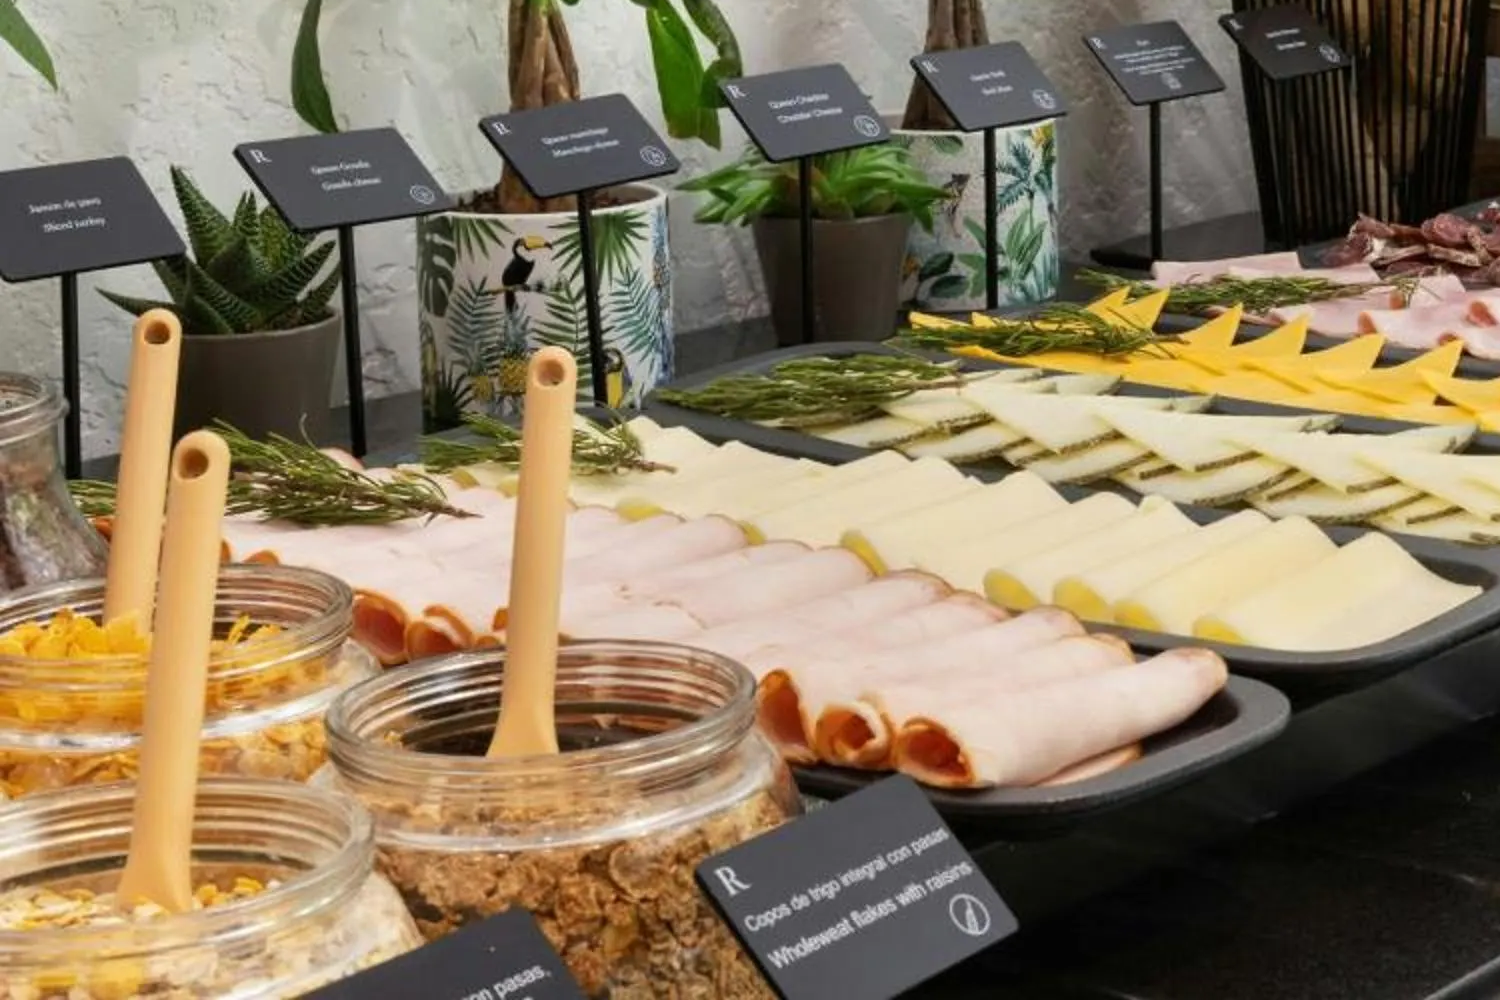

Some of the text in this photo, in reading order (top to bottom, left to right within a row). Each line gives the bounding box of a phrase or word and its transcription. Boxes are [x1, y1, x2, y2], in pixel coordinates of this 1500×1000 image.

[714, 866, 752, 897] R
[744, 827, 950, 932] Copos de trigo integral con pasas
[850, 899, 898, 929] flakes
[895, 882, 928, 907] with
[925, 861, 974, 892] raisins
